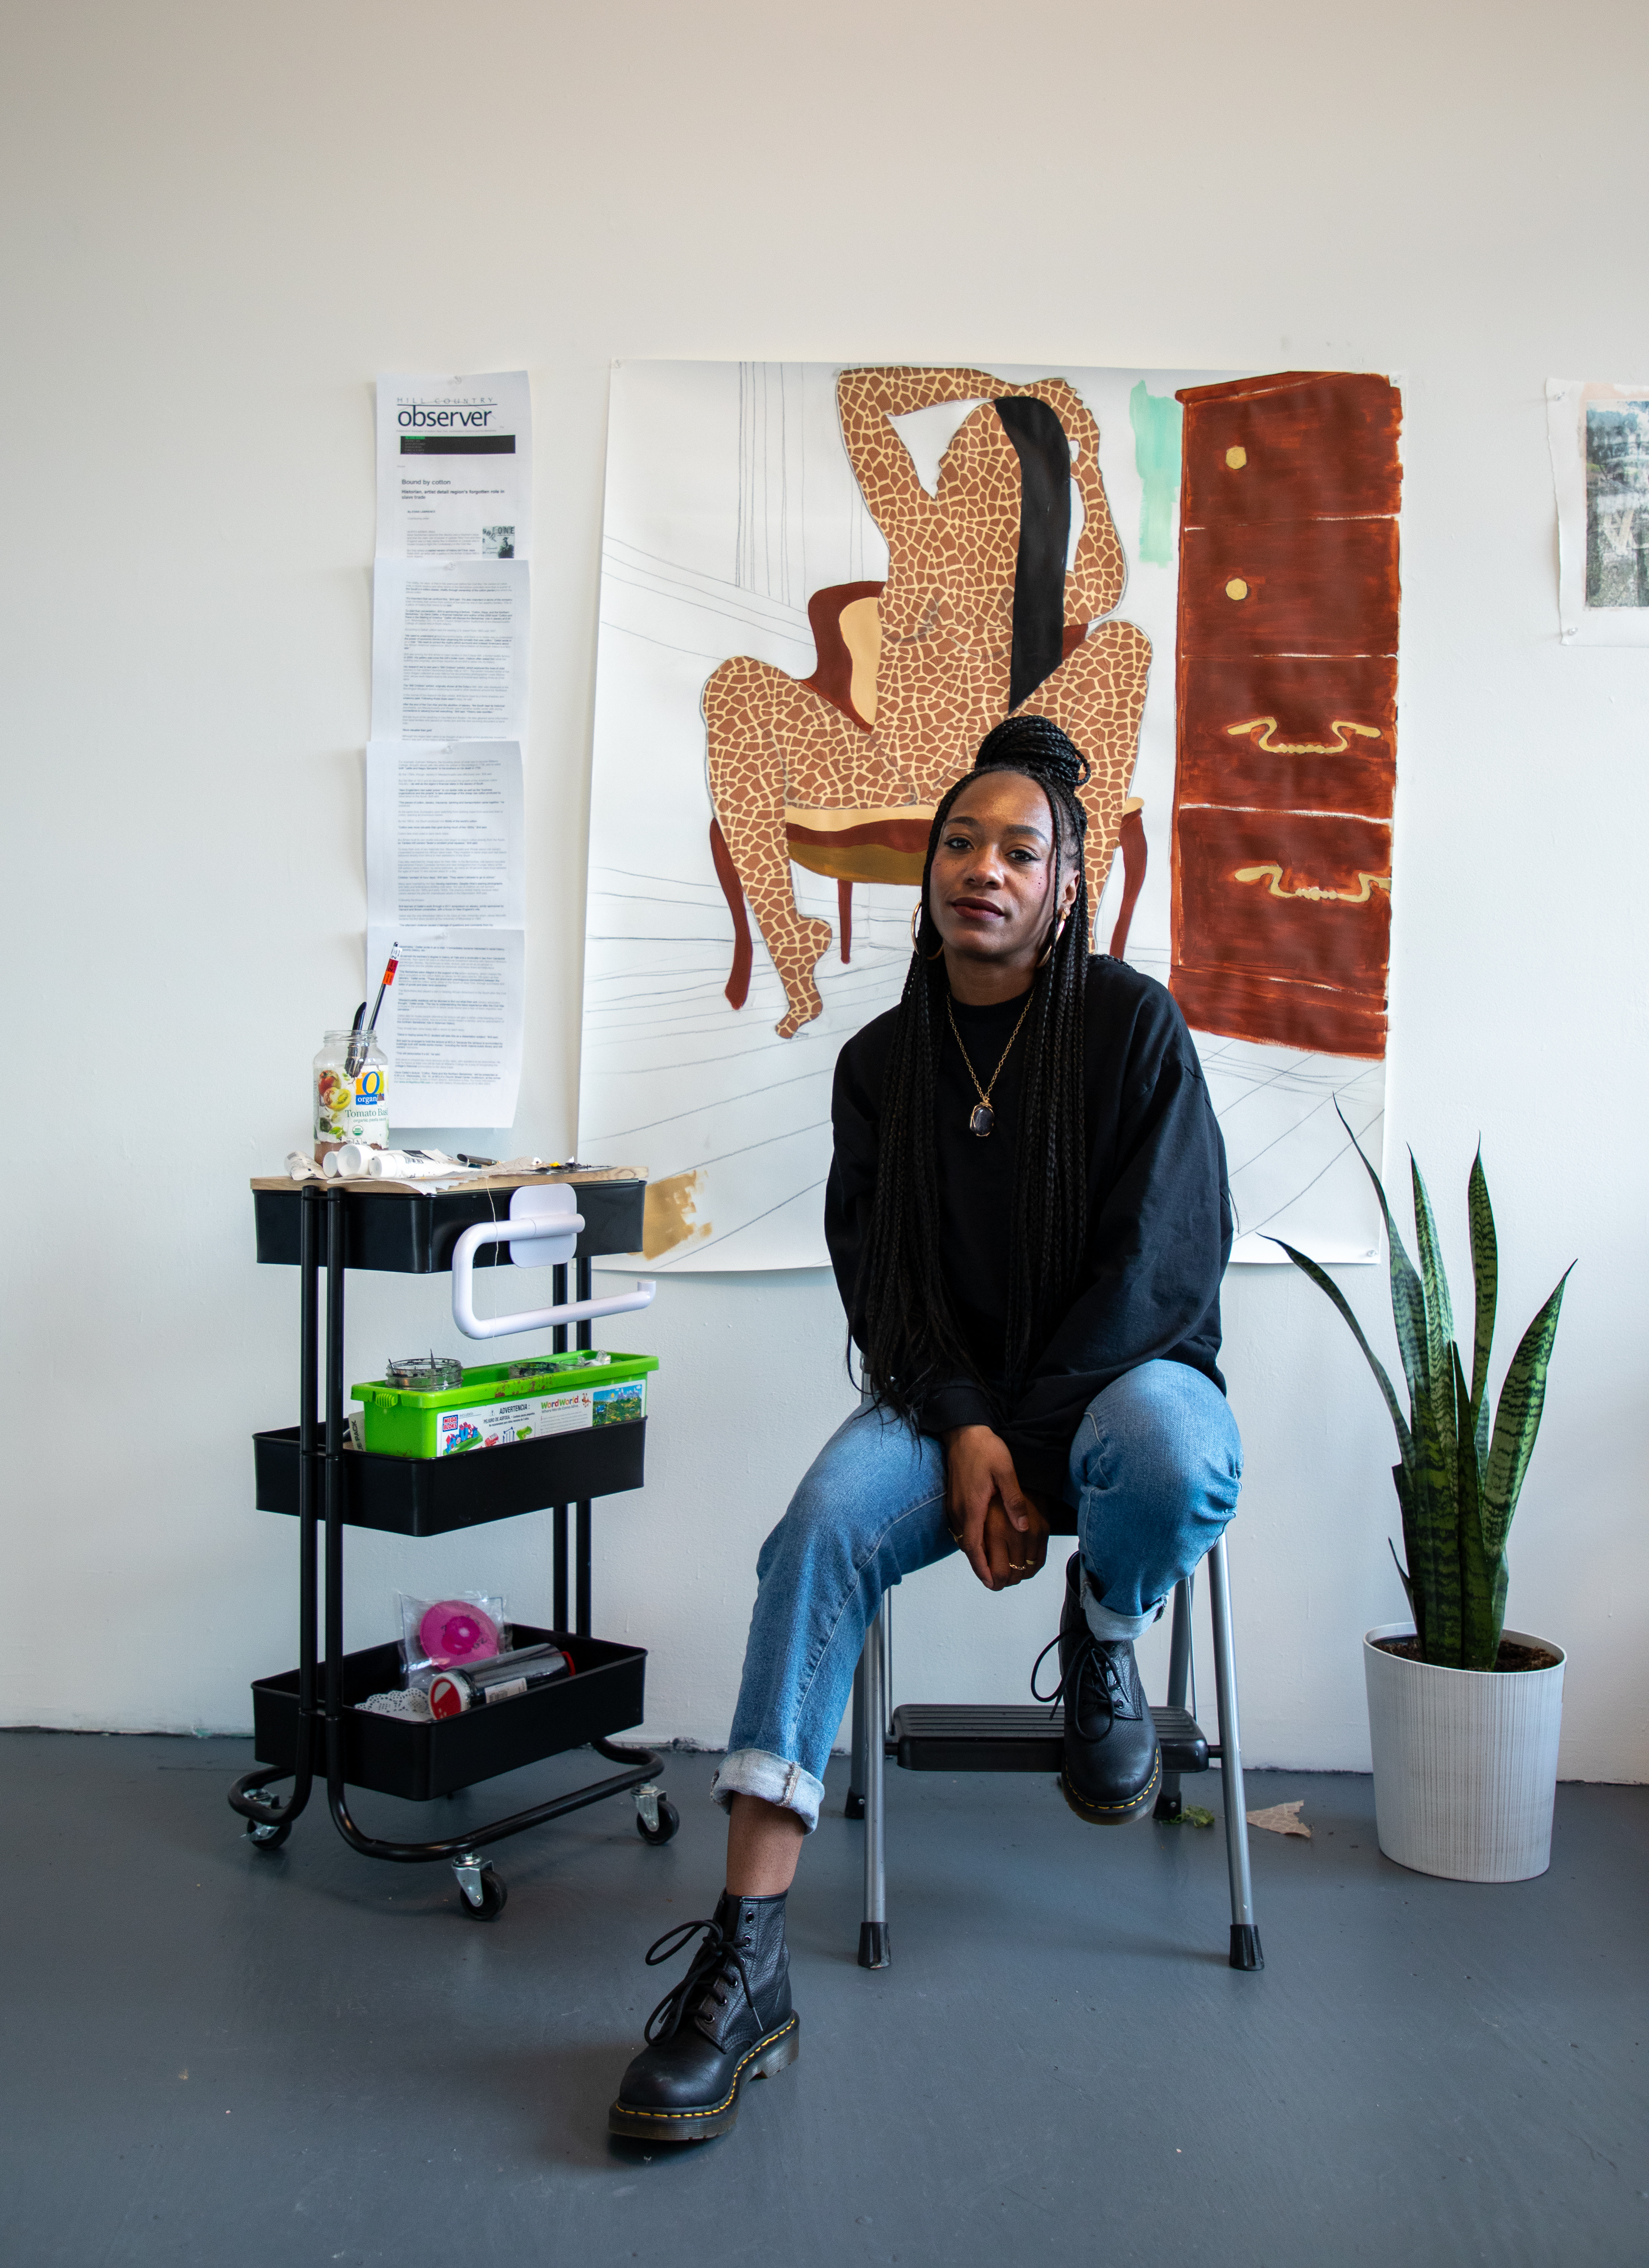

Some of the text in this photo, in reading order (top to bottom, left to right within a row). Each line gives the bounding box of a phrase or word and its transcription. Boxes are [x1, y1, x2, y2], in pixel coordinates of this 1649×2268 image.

[398, 405, 492, 426] observer
[362, 1071, 380, 1095] O
[358, 1095, 380, 1104] organi
[345, 1109, 376, 1118] Tomato
[499, 1404, 527, 1414] ADVERTENCIA
[541, 1395, 579, 1409] WordWorld
[351, 1420, 360, 1441] PACK
